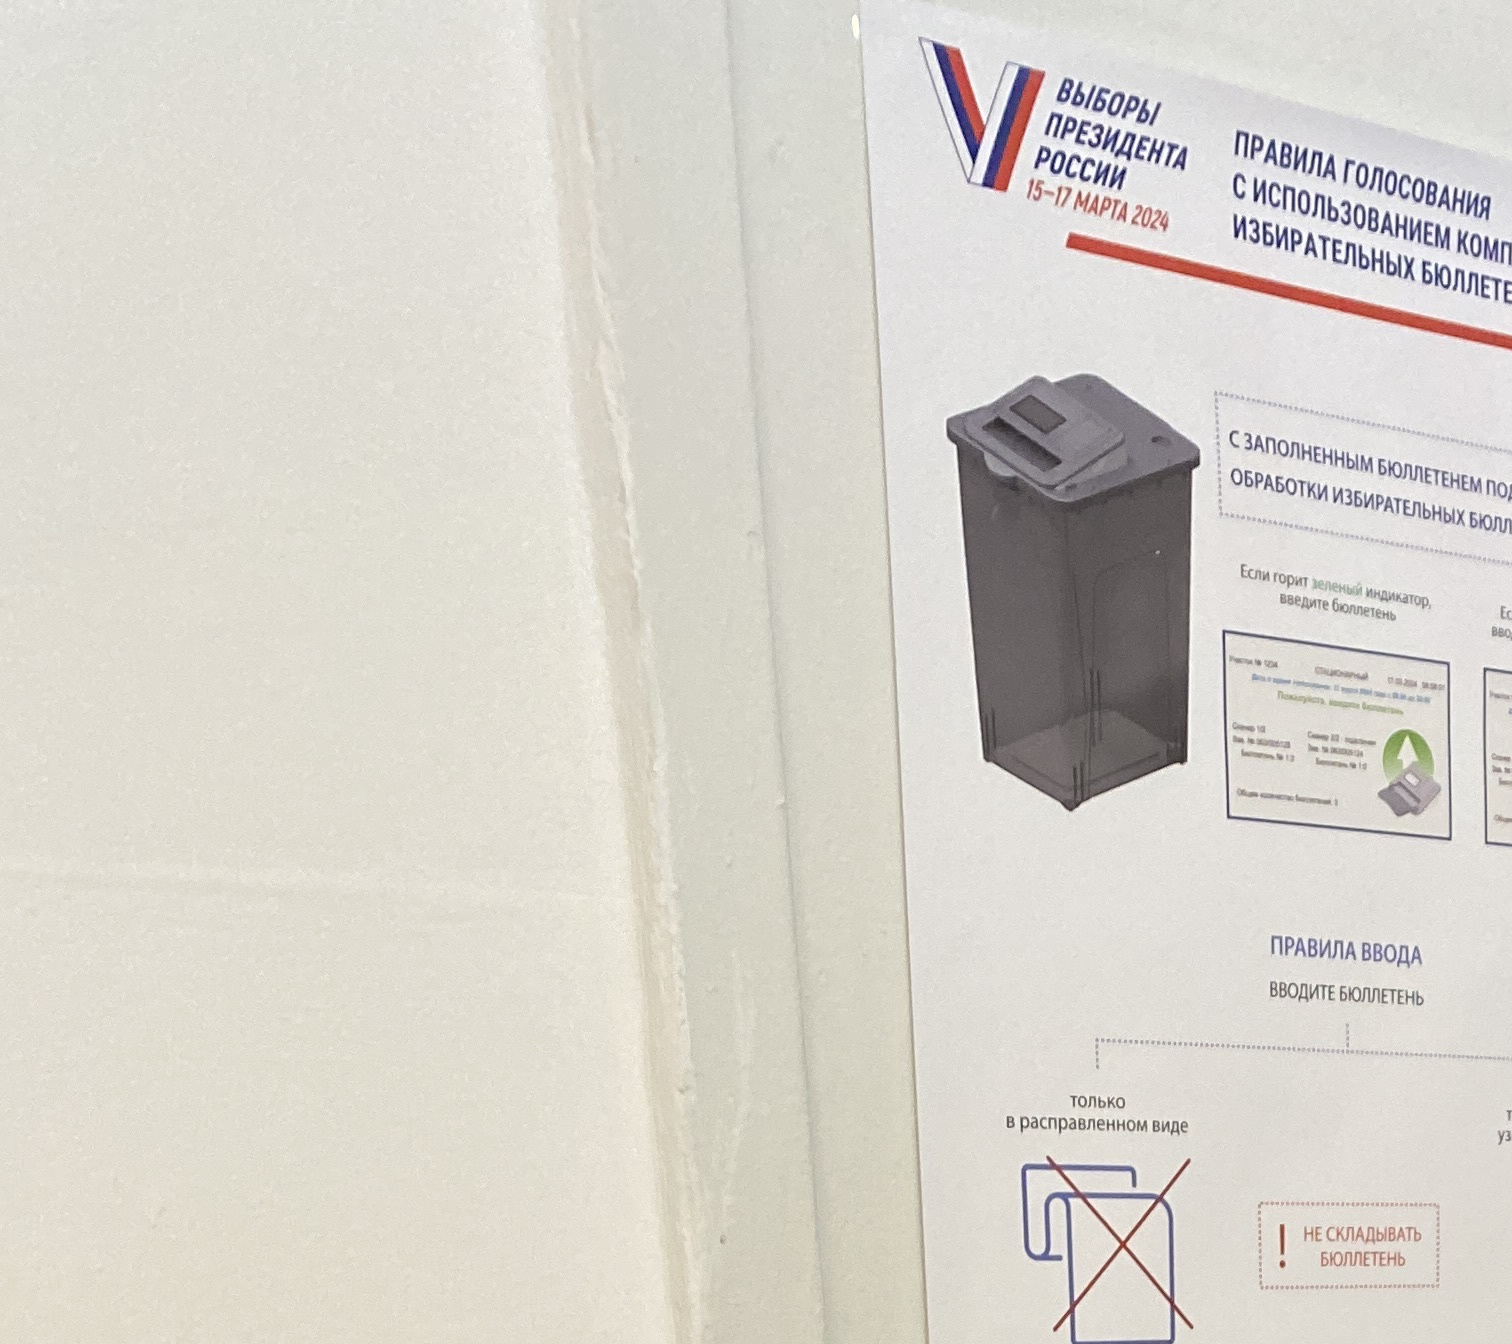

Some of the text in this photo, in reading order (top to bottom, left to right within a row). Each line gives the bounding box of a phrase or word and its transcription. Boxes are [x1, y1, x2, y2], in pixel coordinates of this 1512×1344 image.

[1056, 77, 1162, 126] ВЫБОРЫ
[1044, 111, 1188, 171] ПРЕЗИДЕНТА
[1034, 145, 1128, 190] РОССИИ
[1234, 129, 1492, 221] ПРАВИЛА ГОЛОСОВАНИЯ
[1073, 190, 1129, 223] МАРТА
[1131, 204, 1170, 232] 2024
[1233, 172, 1247, 199] С
[1253, 176, 1450, 250] ИСПОЛЬЗОВАНИЕМ
[1233, 213, 1415, 280] ИЗБИРАТЕЛЬНЫХ
[1229, 430, 1240, 448] С
[1244, 432, 1373, 473] ЗАПОЛНЕННЫМ
[1378, 458, 1482, 494] БЮЛЛЕТЕНЕМ
[1231, 467, 1328, 501] ОБРАБОТКИ
[1333, 485, 1465, 527] ИЗБИРАТЕЛЬНЫХ
[1240, 563, 1432, 610] Если горит зеленый индикатор,
[1280, 593, 1397, 621] введите бюллетень
[1270, 935, 1423, 969] ПРАВИЛА ВВОДА
[1269, 981, 1425, 1006] ВВОДИТЕ БЮЛЛЕТЕНЬ
[1070, 1094, 1126, 1110] только
[1006, 1116, 1189, 1136] в расправленном виде
[1303, 1226, 1422, 1245] НЕ СКЛАДЫВАТЬ
[1320, 1251, 1406, 1267] БЮЛЛЕТЕНЬ
